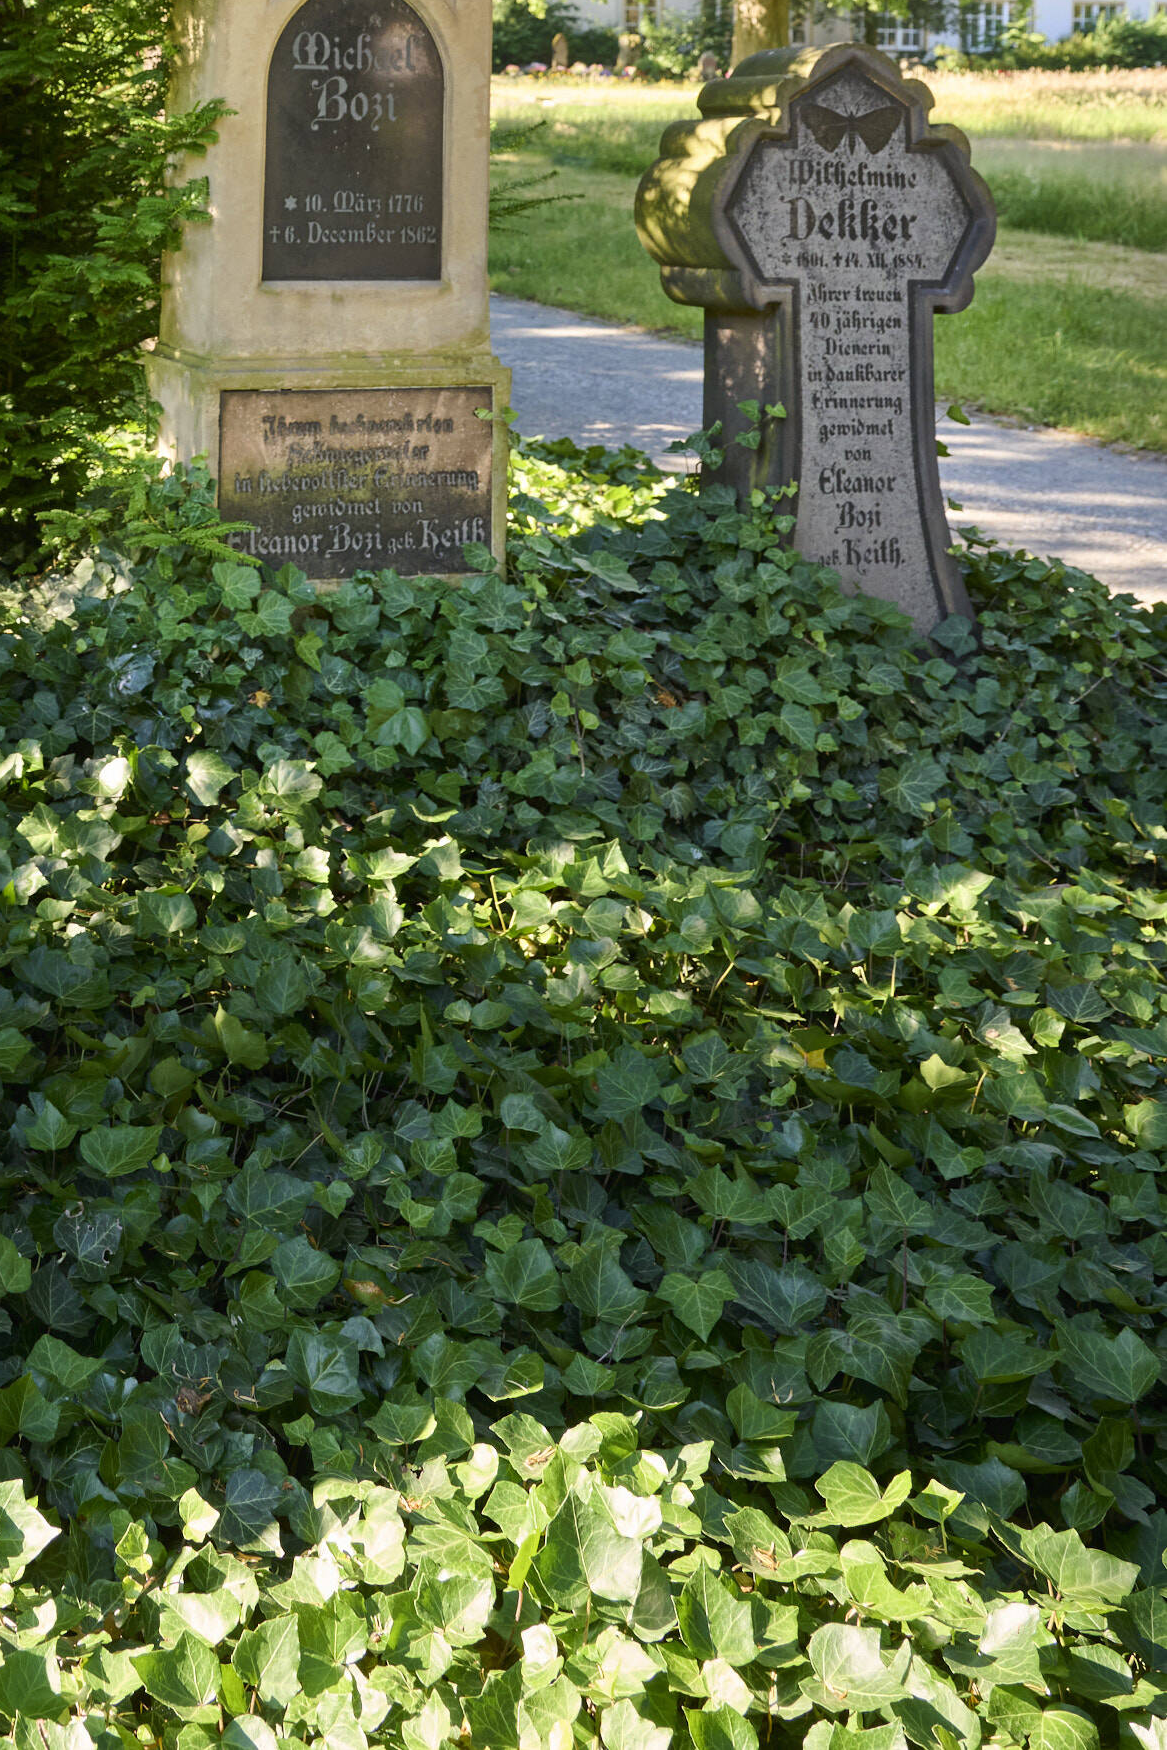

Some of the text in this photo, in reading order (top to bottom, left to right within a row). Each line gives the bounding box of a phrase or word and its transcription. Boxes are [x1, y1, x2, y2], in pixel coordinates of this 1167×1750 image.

[292, 31, 420, 73] Michael
[310, 76, 398, 132] Bozi
[789, 159, 917, 190] Wilhelmine
[305, 190, 424, 218] 10. März 1776
[285, 221, 437, 244] 6. December 1862
[780, 196, 918, 246] Dekker
[807, 284, 902, 306] Ihrer treuen
[809, 311, 902, 335] 40 jährigen
[824, 337, 891, 357] Dienerin
[808, 368, 823, 383] in
[812, 391, 903, 415] Erinnerung
[819, 419, 894, 443] gewidmet
[844, 447, 872, 463] von
[235, 472, 252, 493] in
[373, 467, 480, 491] Erinnerung
[818, 464, 897, 495] Eleanor
[292, 499, 423, 523] gewidmet von
[835, 502, 881, 535] Bozi
[228, 525, 324, 556] Eleanor
[325, 522, 382, 558] Bozi
[388, 531, 417, 554] geb.
[842, 538, 906, 575] Keith.
